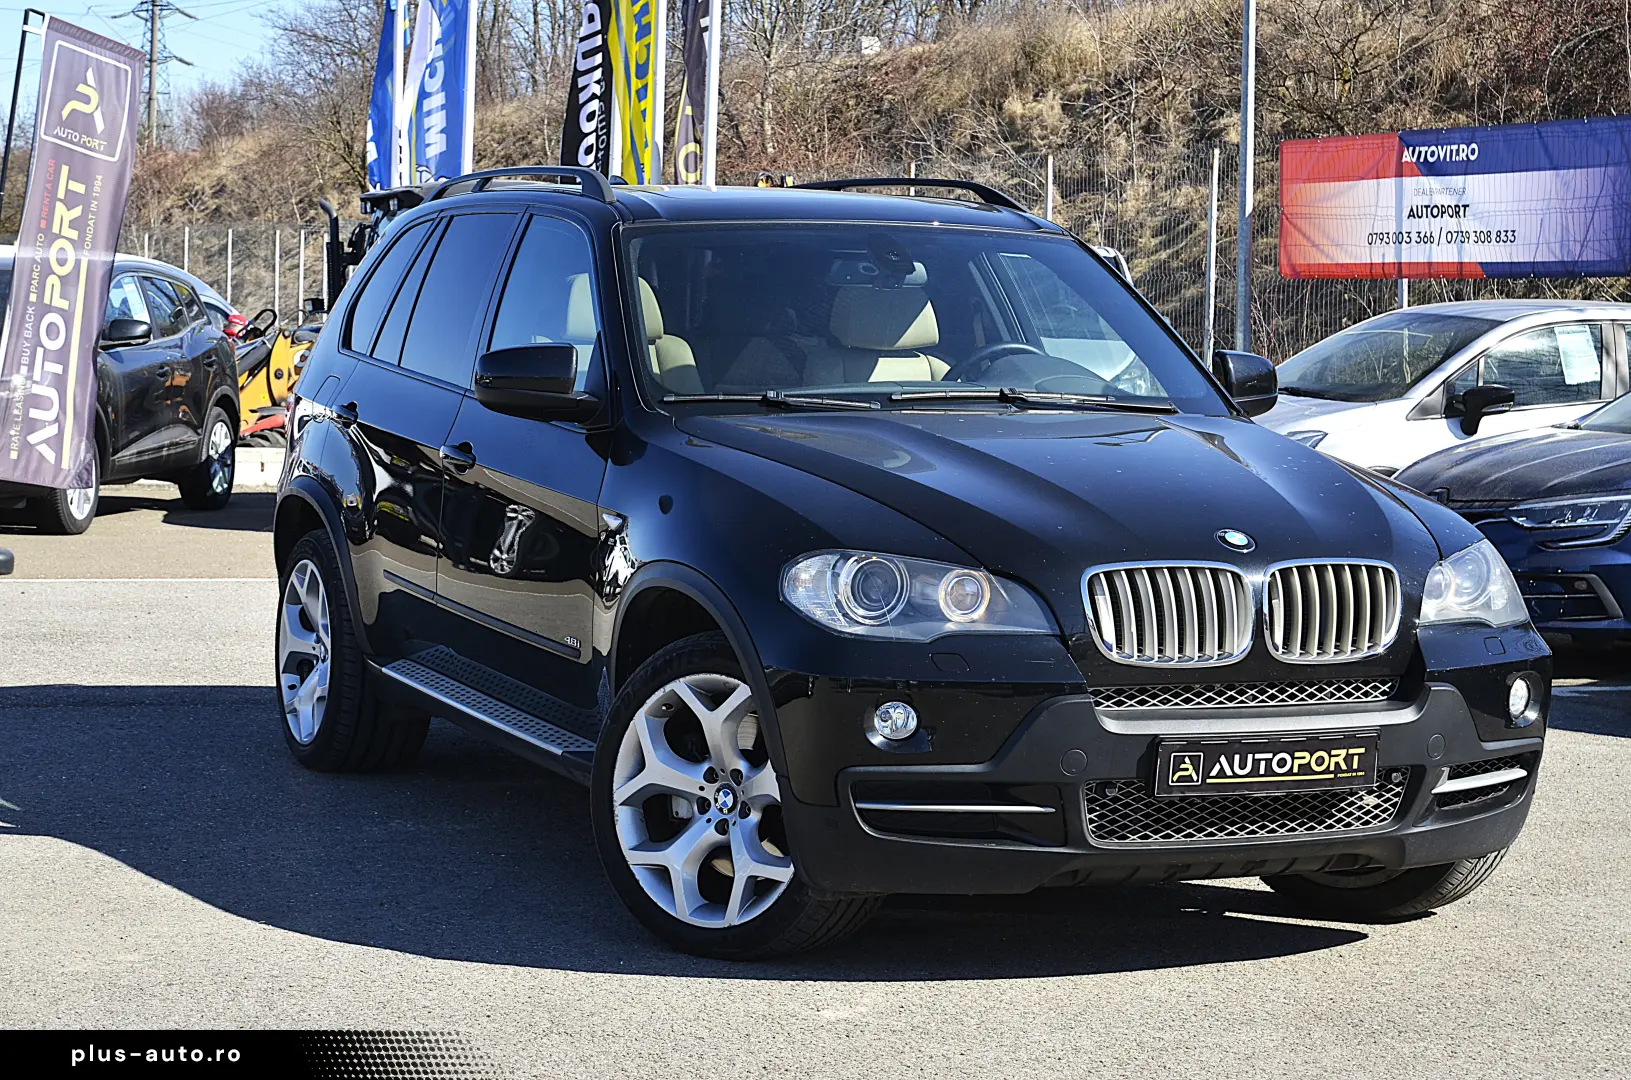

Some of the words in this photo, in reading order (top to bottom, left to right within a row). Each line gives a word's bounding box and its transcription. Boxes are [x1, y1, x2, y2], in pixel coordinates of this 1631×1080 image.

[53, 125, 80, 142] AUTO
[80, 134, 107, 151] PORT
[1402, 143, 1479, 163] AUTOVIT.RO
[47, 159, 56, 180] CAR
[92, 174, 103, 197] 1994
[41, 191, 51, 218] RENT
[90, 200, 98, 211] IN
[1407, 204, 1469, 219] AUTOPORT
[34, 233, 45, 262] AUTO
[83, 213, 97, 257] FONDAT
[1367, 232, 1390, 245] 0793
[1391, 231, 1412, 245] 003
[1415, 230, 1435, 244] 366
[1437, 226, 1443, 247] /
[1446, 230, 1471, 244] 0739
[1473, 230, 1492, 244] 308
[1495, 229, 1516, 243] 833
[30, 264, 40, 292] PARC
[24, 305, 35, 338] BACK
[26, 164, 86, 465] AUTOPORT
[21, 340, 31, 364] BUY
[10, 424, 20, 449] RATE
[1209, 747, 1366, 777] AUTOPORT
